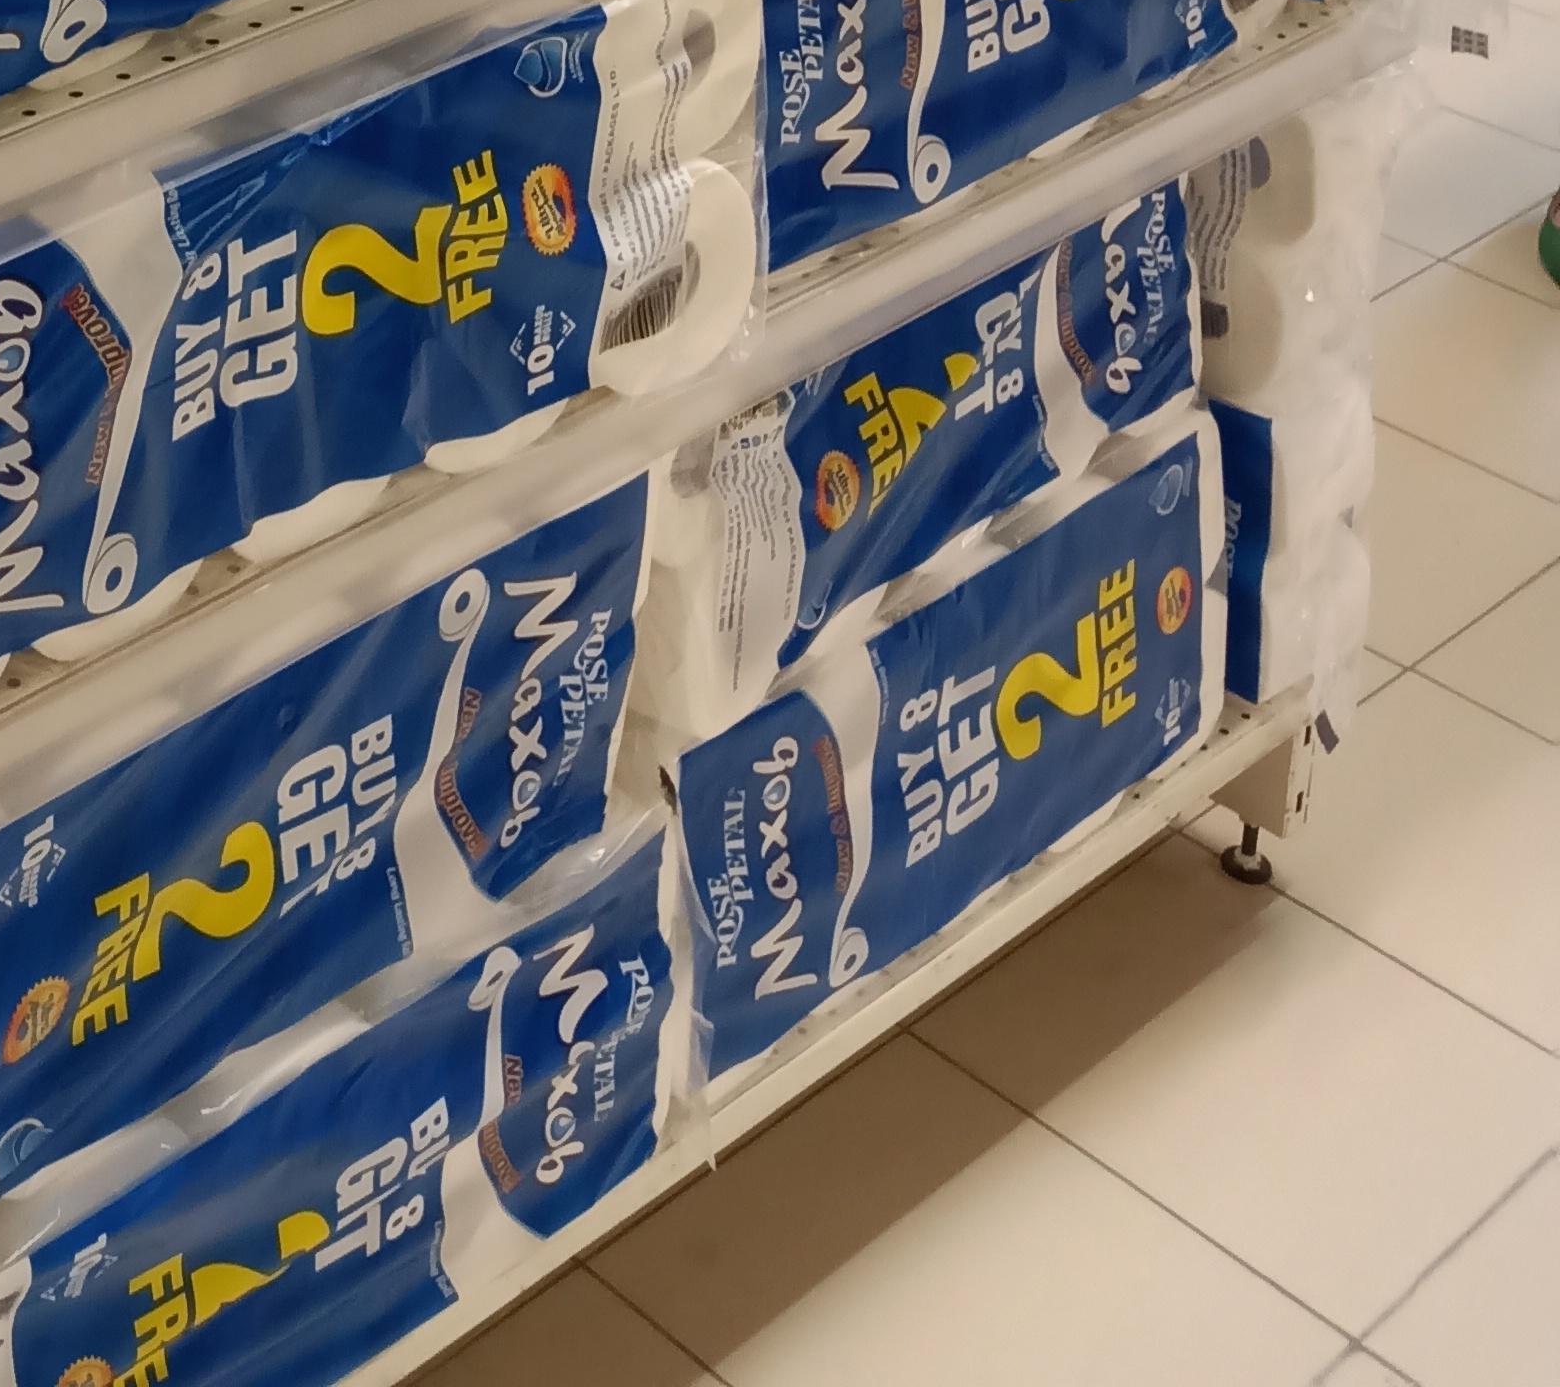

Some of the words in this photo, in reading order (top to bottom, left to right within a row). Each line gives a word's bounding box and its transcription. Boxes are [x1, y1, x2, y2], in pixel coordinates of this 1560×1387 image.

[219, 231, 300, 409] GET
[302, 202, 452, 337] 2
[440, 149, 508, 325] FREE
[171, 307, 216, 442] BUY
[996, 613, 1105, 763] 2
[1099, 558, 1140, 727] FREE
[904, 740, 944, 869] BUY
[939, 659, 999, 841] GET
[73, 871, 153, 1048] FREE
[132, 819, 277, 982] 2
